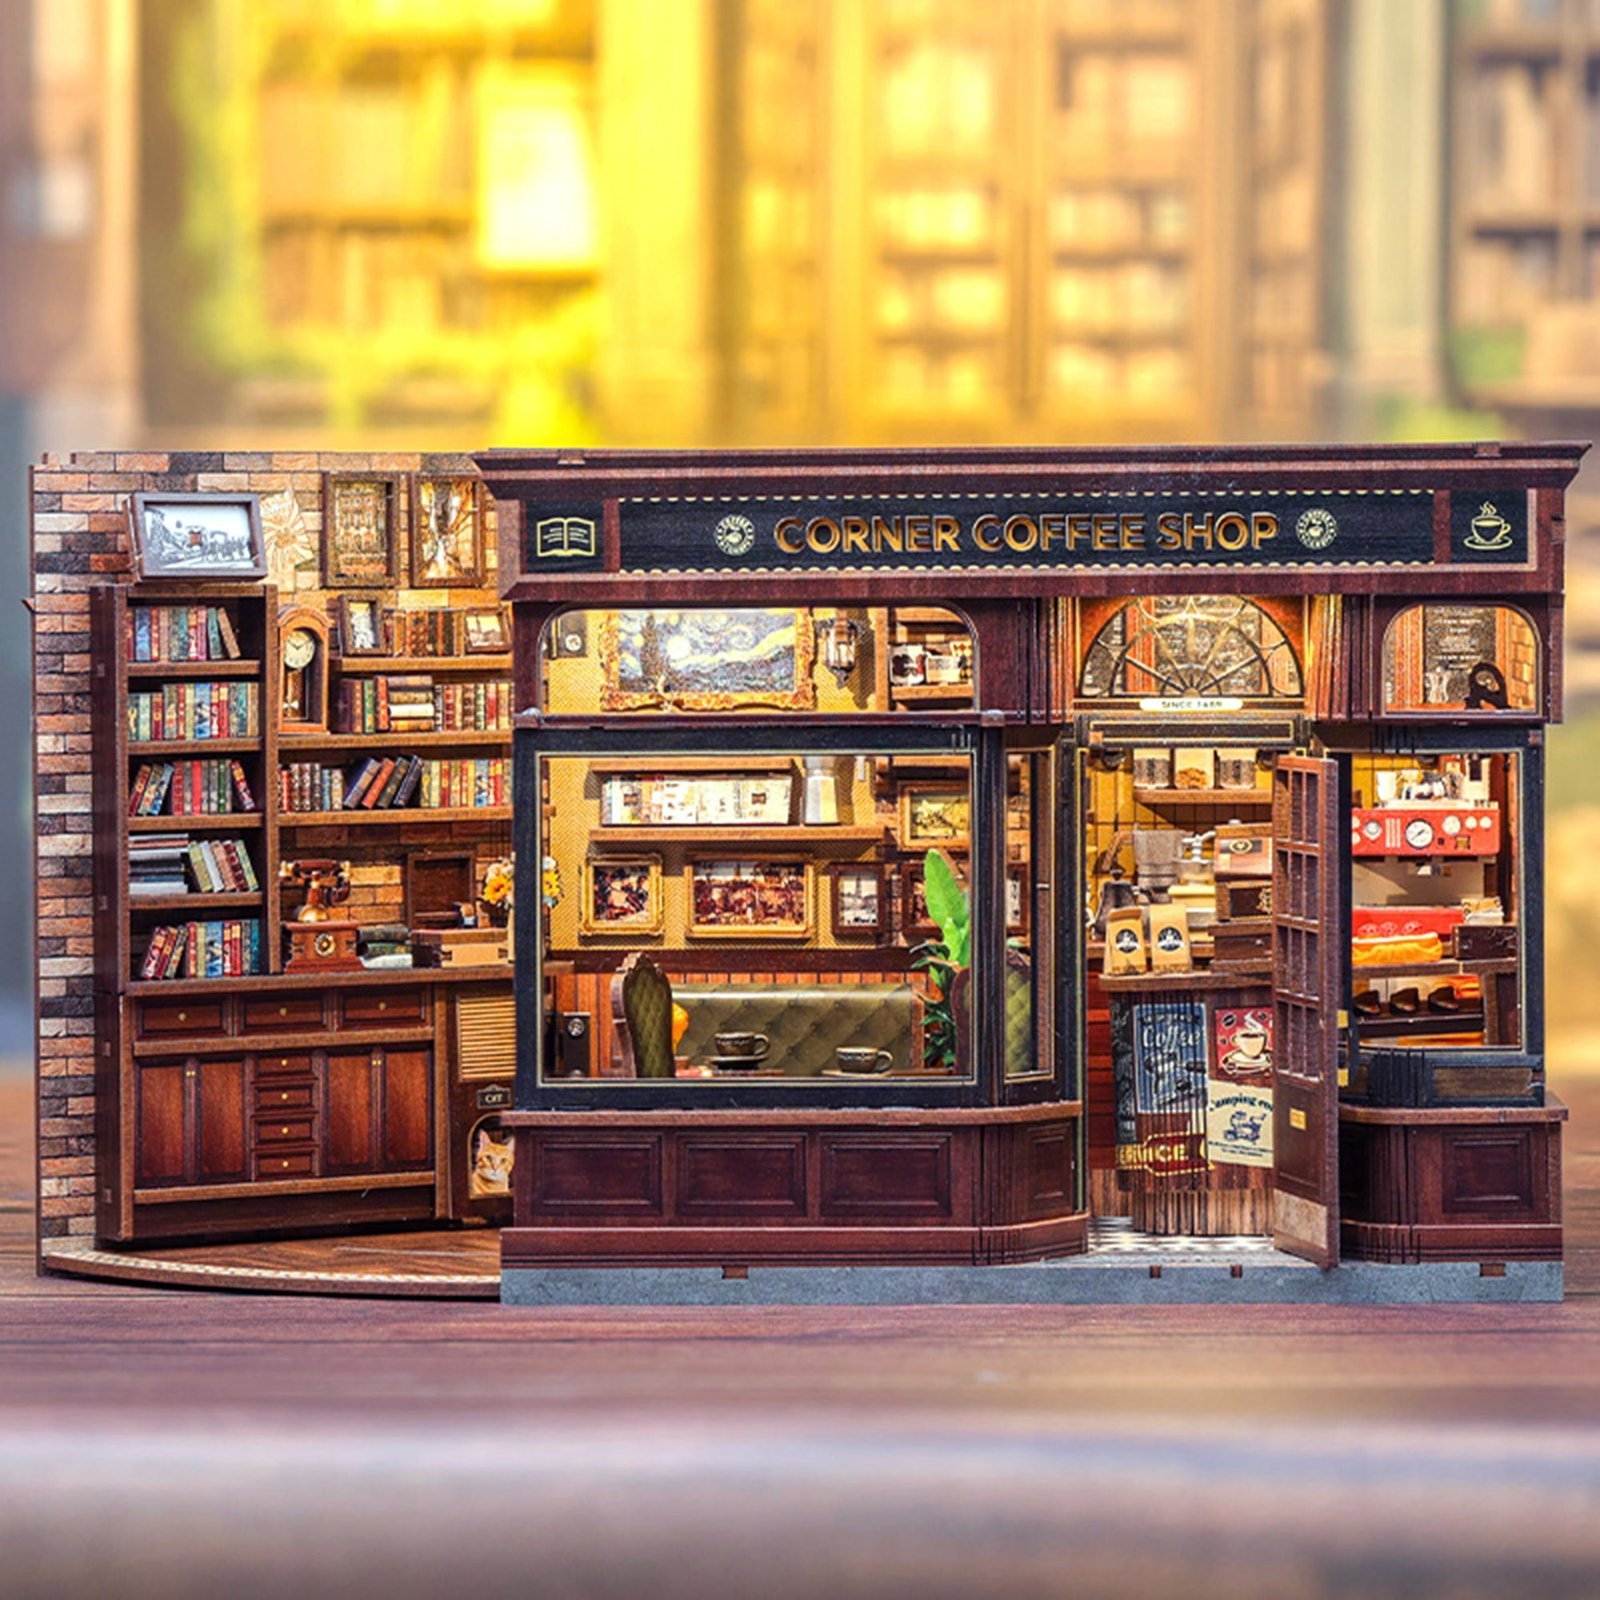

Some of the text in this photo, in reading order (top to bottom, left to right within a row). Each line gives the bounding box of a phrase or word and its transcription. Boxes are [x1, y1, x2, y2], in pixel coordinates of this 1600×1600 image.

[773, 515, 961, 553] CORNER
[972, 513, 1147, 552] COFFEE
[1157, 512, 1279, 551] SHOP
[1161, 701, 1192, 709] SINCE
[1142, 1025, 1201, 1053] Coffee
